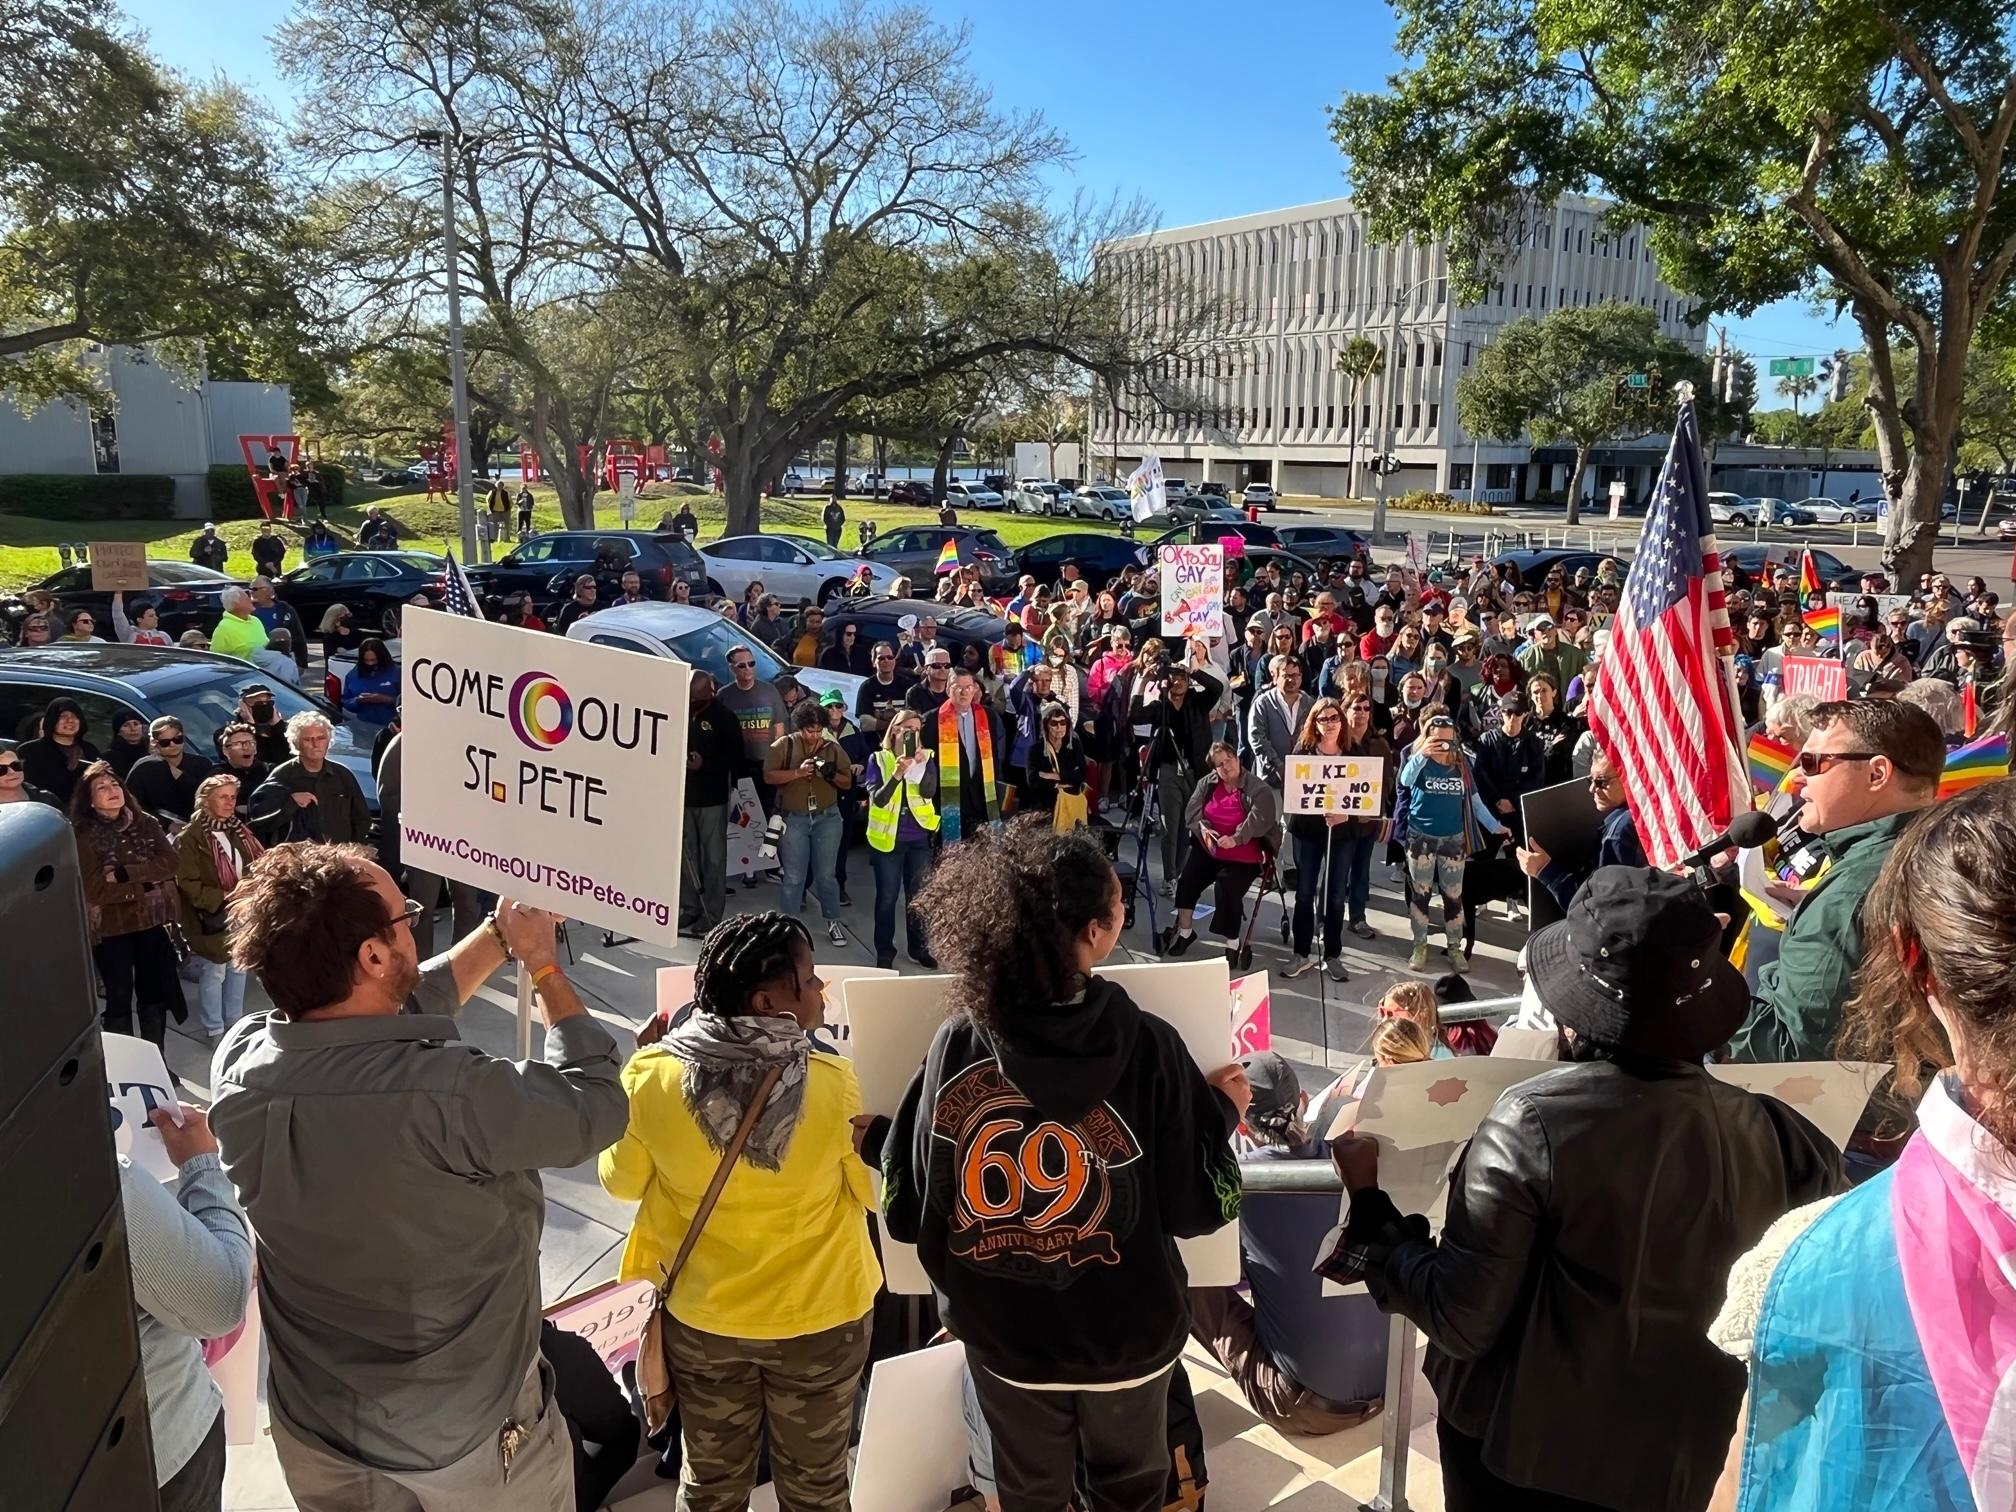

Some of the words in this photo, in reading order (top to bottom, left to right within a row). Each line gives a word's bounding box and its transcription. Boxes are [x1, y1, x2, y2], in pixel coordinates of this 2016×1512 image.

[1163, 545, 1184, 567] OK
[1200, 547, 1222, 572] Say
[1176, 566, 1205, 583] GAY
[1189, 611, 1210, 624] GAY
[1785, 662, 1844, 701] STRAIGHT
[412, 657, 505, 719] COME
[577, 696, 669, 756] OUT
[1323, 763, 1359, 780] KID
[518, 759, 608, 826] PETE
[1349, 781, 1381, 794] NOT
[1425, 780, 1461, 791] CROSS
[405, 827, 669, 926] www.ComeOUTStPete.org
